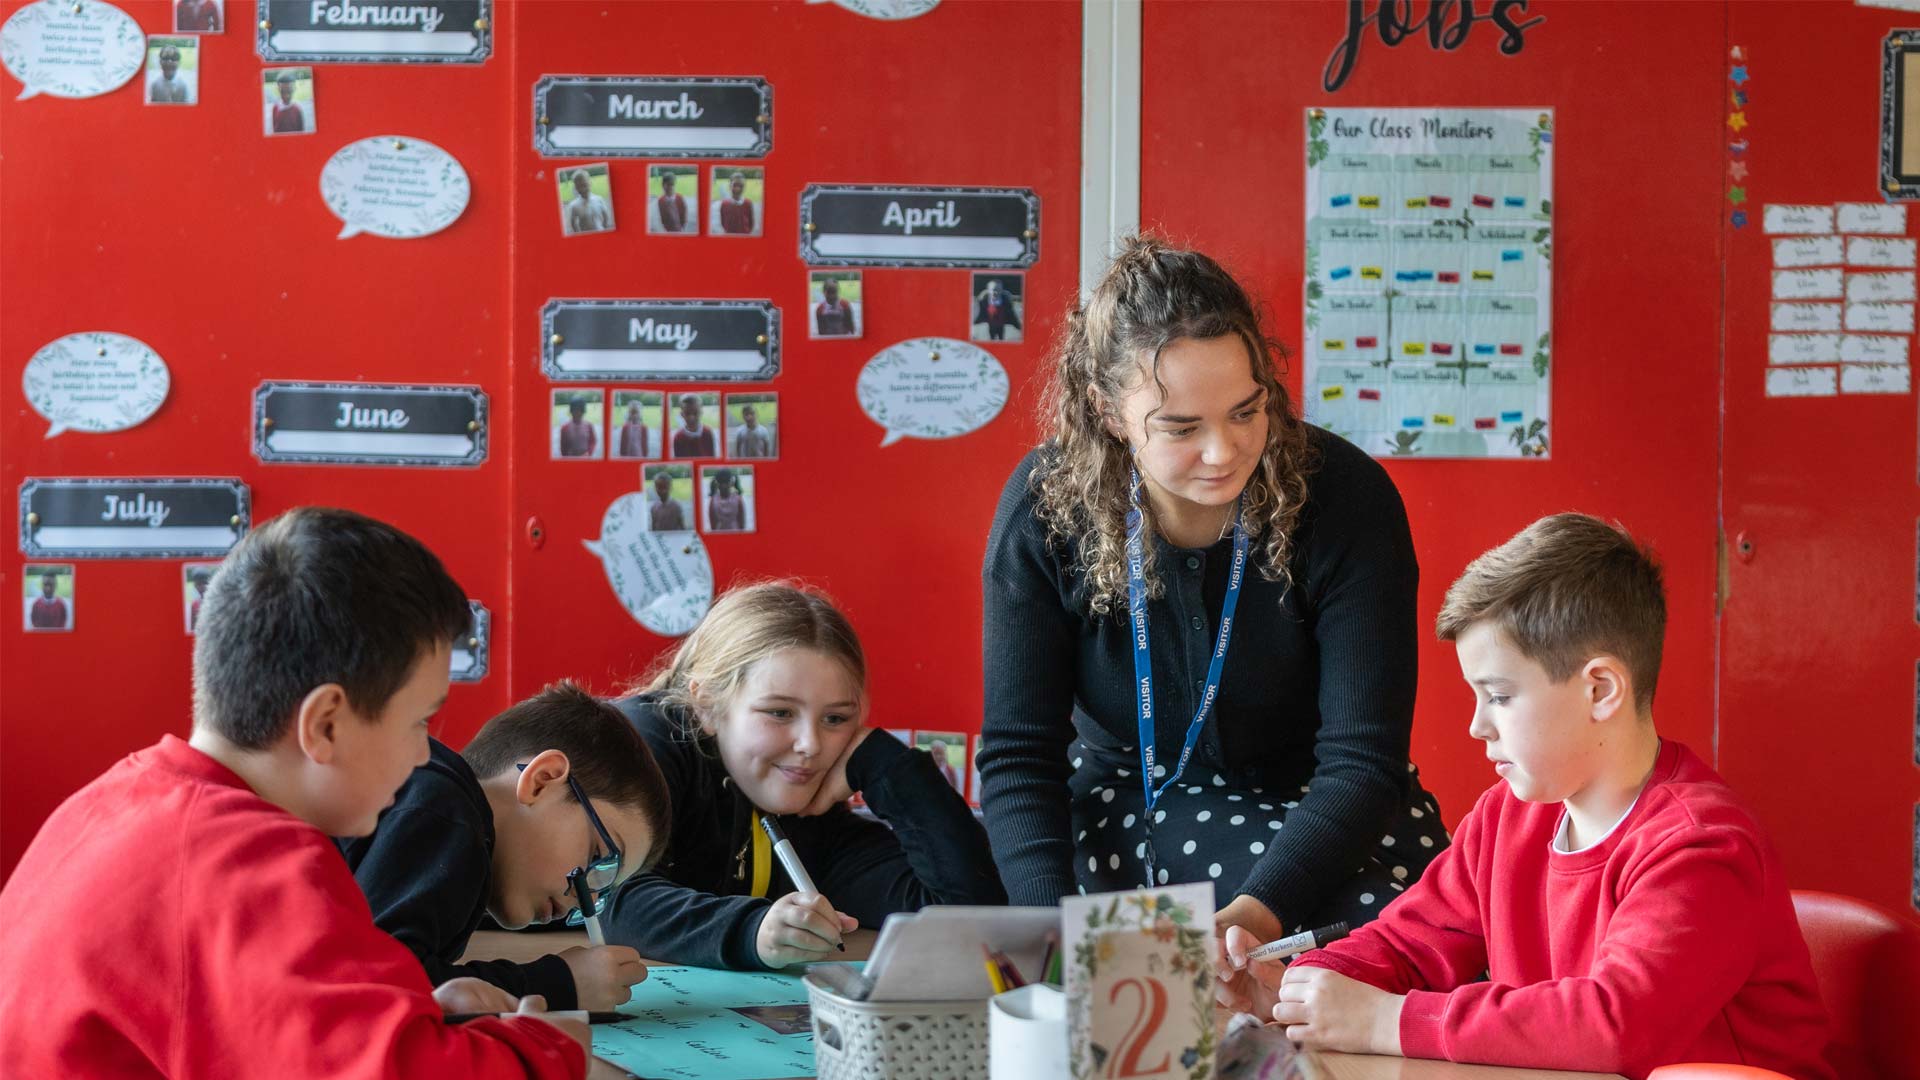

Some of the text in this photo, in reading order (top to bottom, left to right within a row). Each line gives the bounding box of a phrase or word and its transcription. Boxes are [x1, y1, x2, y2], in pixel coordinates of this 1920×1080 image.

[310, 0, 444, 33] February
[607, 92, 704, 120] March
[1334, 117, 1495, 140] Our Class Monitors
[882, 200, 961, 235] April
[629, 317, 698, 351] May
[52, 370, 96, 380] birthdays
[890, 383, 912, 392] have
[923, 382, 966, 393] difference
[914, 373, 932, 382] any
[934, 370, 968, 379] months
[335, 401, 411, 429] June
[101, 493, 171, 528] July
[656, 532, 672, 558] hich
[1131, 538, 1143, 580] VISITOR
[1230, 549, 1244, 590] VISITOR
[1136, 608, 1148, 650] VISITOR
[1216, 617, 1231, 658] VISITOR
[1140, 676, 1151, 719] VISITOR
[1196, 684, 1217, 723] VISITOR
[1107, 976, 1172, 1080] 2
